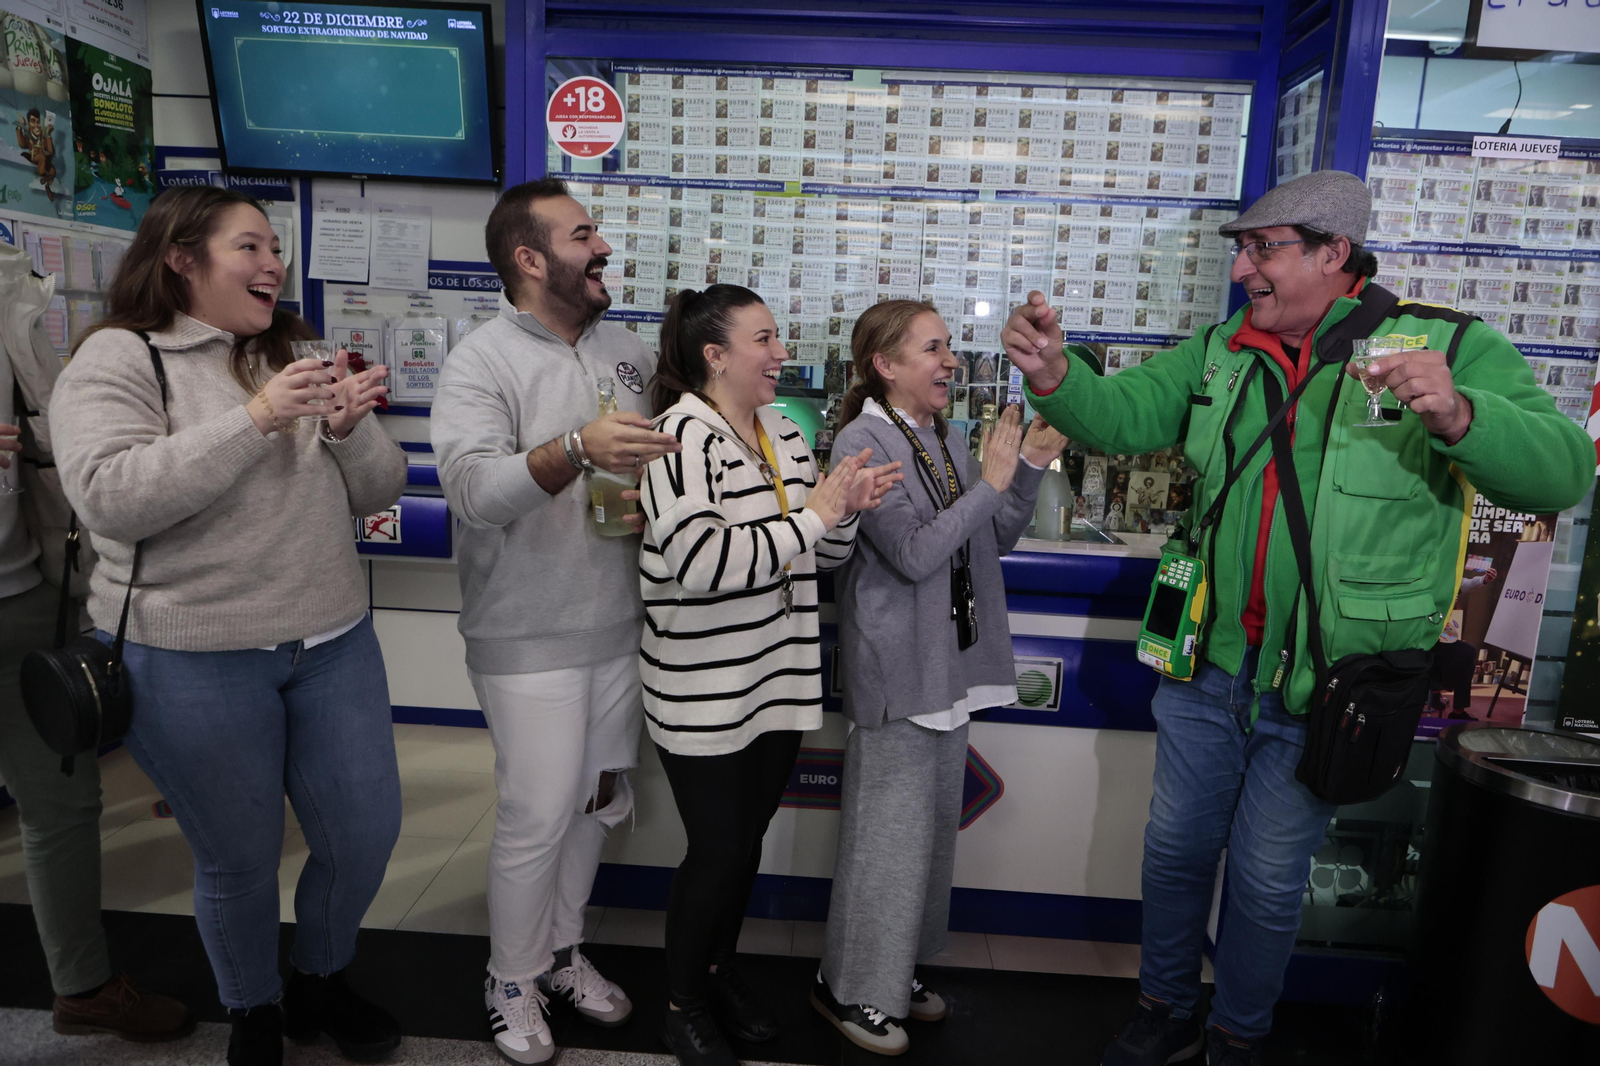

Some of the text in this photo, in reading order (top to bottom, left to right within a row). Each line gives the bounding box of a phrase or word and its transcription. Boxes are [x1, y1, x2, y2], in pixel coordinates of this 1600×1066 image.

[283, 11, 404, 29] 22 DE DICIEMBRE
[261, 25, 296, 34] SORTEO
[298, 26, 376, 38] EXTRAORDINARIO
[391, 32, 428, 40] NAVIDAD
[92, 72, 132, 98] OJALÁ
[563, 86, 606, 112] +18
[1474, 141, 1558, 154] LOTERIA JUEVES
[160, 176, 288, 187] Loteria Nacional
[446, 278, 482, 287] DE LOS
[1470, 519, 1523, 533] DE SER
[1505, 589, 1525, 600] EURO
[1149, 645, 1168, 658] ONCE
[800, 774, 838, 785] EURO
